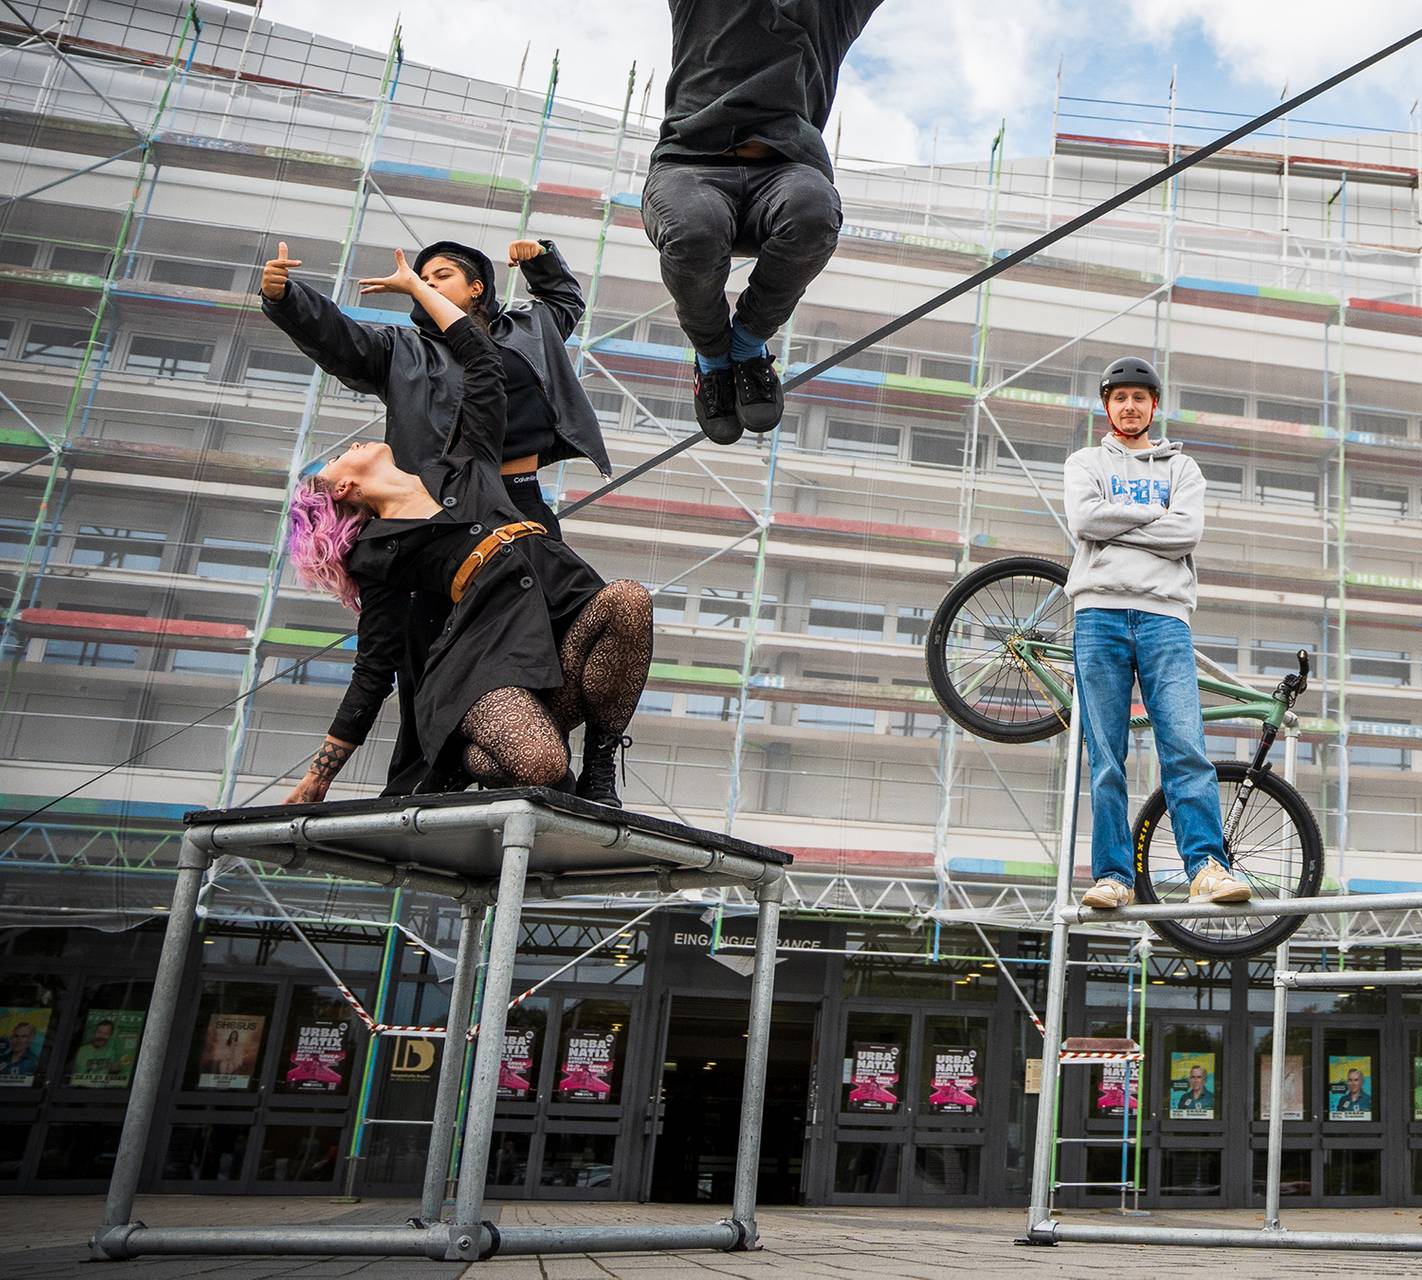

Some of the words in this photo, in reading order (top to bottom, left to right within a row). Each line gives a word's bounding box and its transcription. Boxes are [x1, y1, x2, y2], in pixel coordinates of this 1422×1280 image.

[1137, 820, 1150, 873] MAXXIS
[299, 1036, 343, 1046] NATIX
[569, 1047, 610, 1058] NATIX
[857, 1059, 895, 1069] NATIX
[935, 1063, 973, 1073] NATIX
